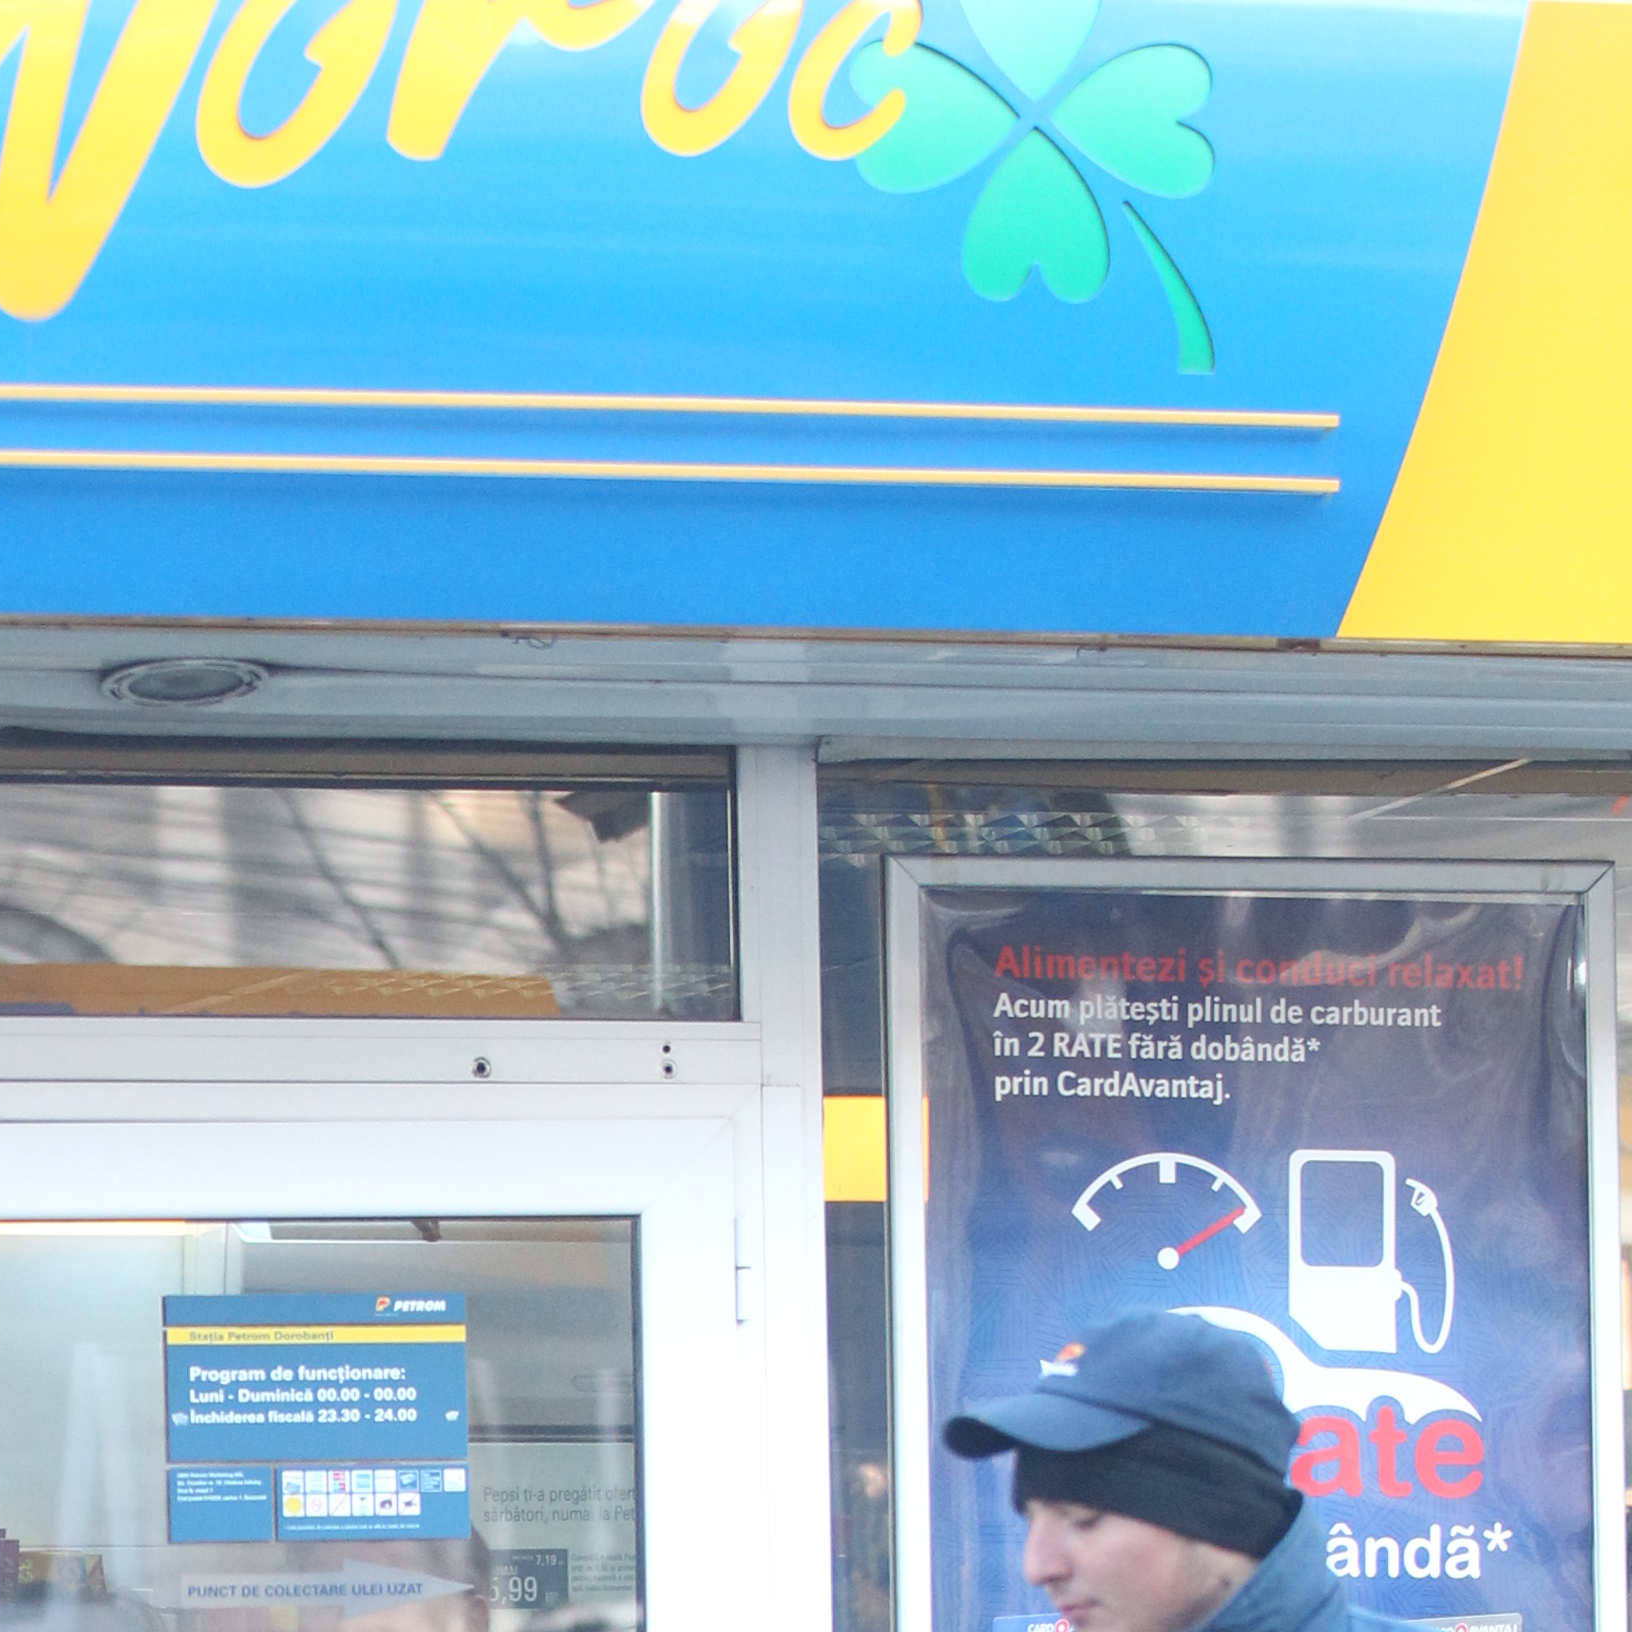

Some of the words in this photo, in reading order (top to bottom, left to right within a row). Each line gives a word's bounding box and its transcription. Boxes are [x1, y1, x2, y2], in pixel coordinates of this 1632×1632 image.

[995, 945, 1186, 982] Alimentezi
[1198, 949, 1225, 988] și
[1236, 952, 1376, 985] conduci
[1388, 956, 1524, 989] relaxat!
[992, 992, 1069, 1019] Acum
[1079, 995, 1178, 1027] plătești
[1187, 998, 1263, 1029] plinul
[1269, 999, 1304, 1025] de
[1310, 1000, 1441, 1028] carburant
[992, 1031, 1020, 1057] în
[1027, 1032, 1046, 1057] 2
[1053, 1034, 1123, 1059] RATE
[1128, 1033, 1183, 1061] fără
[994, 1072, 1049, 1102] prin
[1057, 1071, 1231, 1104] CardAvantaj.
[393, 1299, 446, 1312] PETROM
[227, 1331, 270, 1342] Petrom
[189, 1366, 265, 1385] Program
[270, 1366, 293, 1381] de
[298, 1365, 406, 1384] funcționare:
[189, 1389, 224, 1403] Luni
[238, 1387, 313, 1403] Duminică
[317, 1387, 360, 1402] 00.00
[373, 1387, 417, 1401] 00.00
[190, 1407, 265, 1424] Închiderea
[268, 1408, 314, 1424] fiscală
[317, 1408, 360, 1423] 23.30
[374, 1407, 417, 1422] 24.00
[187, 1585, 236, 1598] PUNCT
[241, 1585, 259, 1598] DE
[264, 1584, 346, 1597] COLECTARE
[351, 1583, 383, 1596] ULEI
[387, 1582, 423, 1596] UZAT
